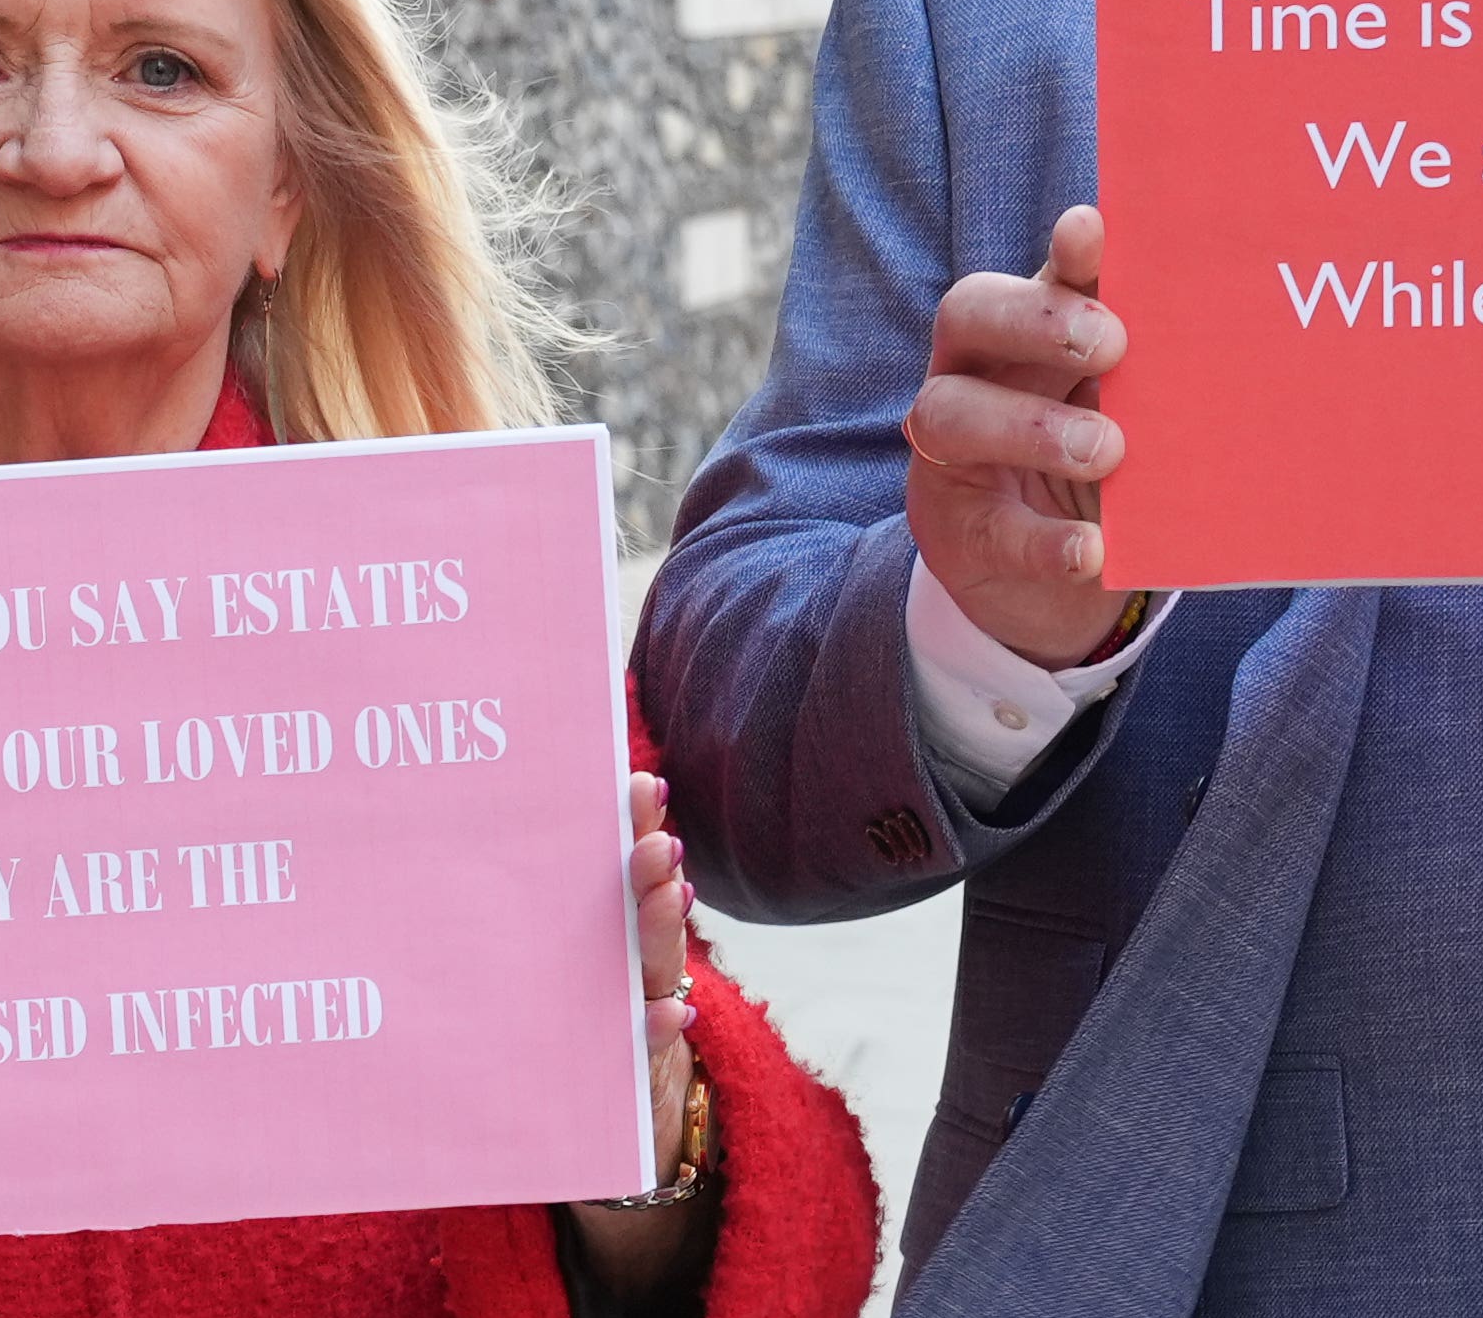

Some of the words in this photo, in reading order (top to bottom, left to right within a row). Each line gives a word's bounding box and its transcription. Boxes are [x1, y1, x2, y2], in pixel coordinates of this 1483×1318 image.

[1306, 121, 1451, 188] We
[70, 577, 187, 646] SAY
[208, 559, 468, 636] ESTATES
[3, 725, 124, 792] OUR
[141, 711, 333, 783] LOVED
[355, 699, 506, 768] ONES
[44, 849, 162, 917] ARE
[178, 840, 296, 907] THE
[107, 977, 382, 1054] INFECTED
